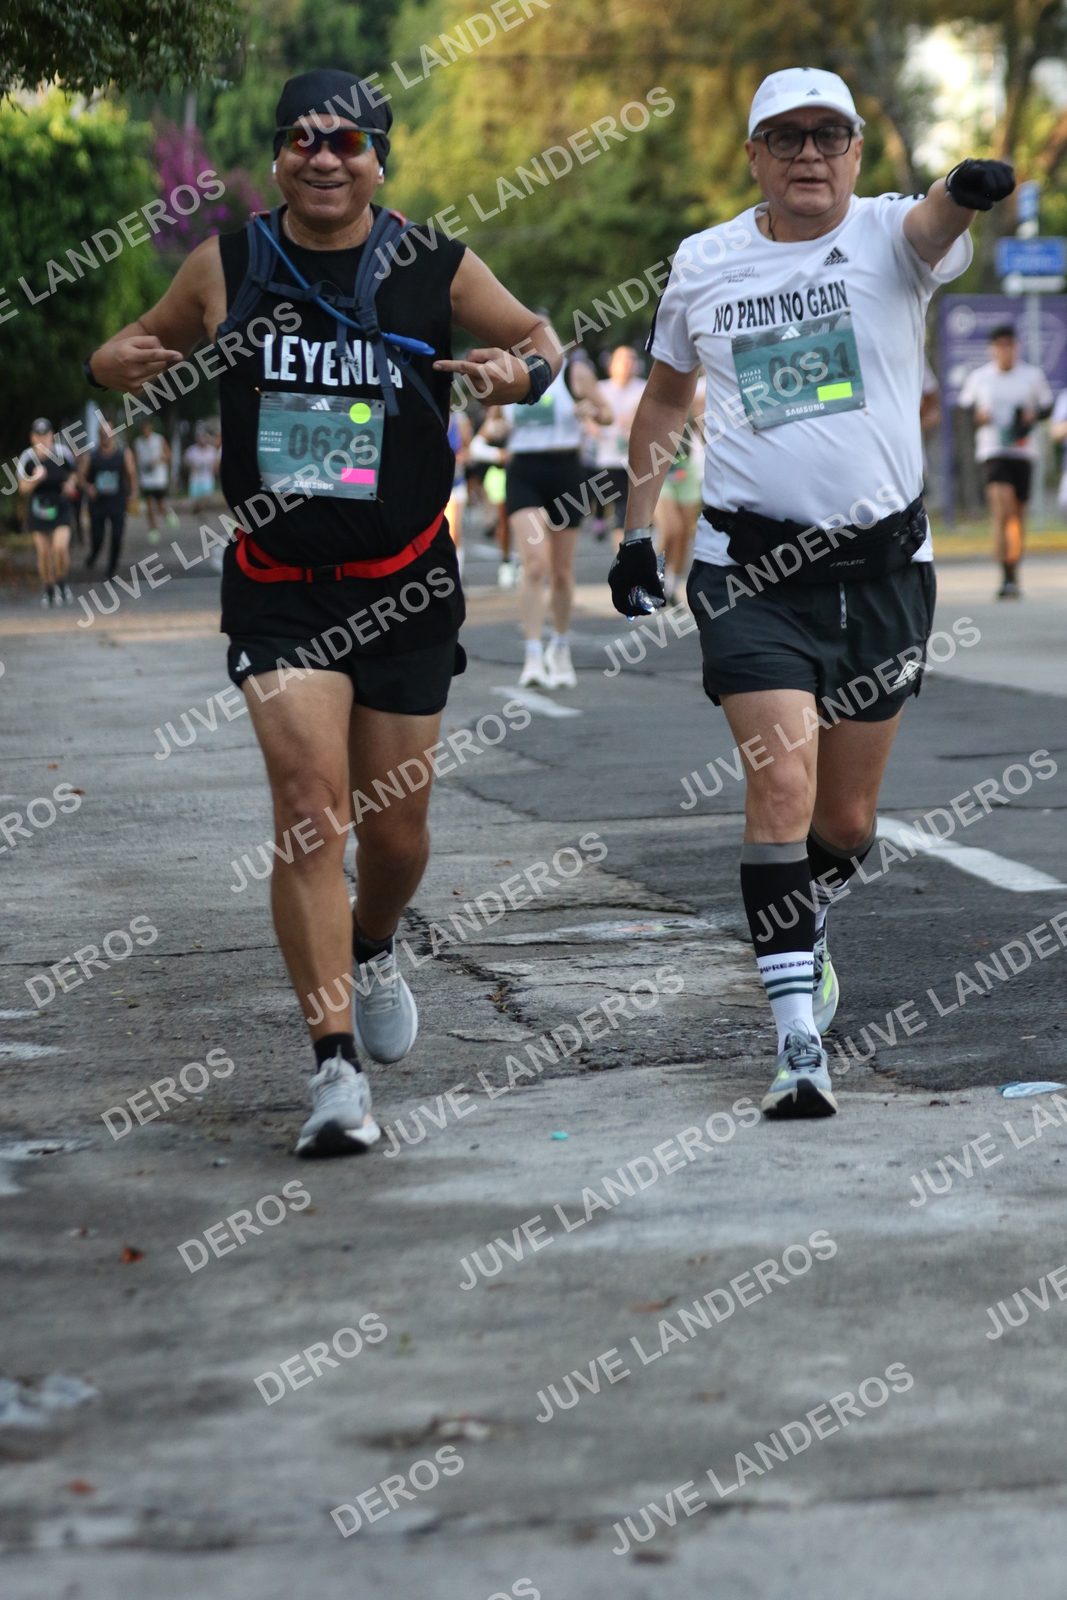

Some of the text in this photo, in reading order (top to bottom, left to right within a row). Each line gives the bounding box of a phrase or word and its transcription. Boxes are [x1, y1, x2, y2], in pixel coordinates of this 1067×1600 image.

[712, 280, 849, 333] NO PAIN NO GAIN
[785, 402, 825, 416] SAMSUNG
